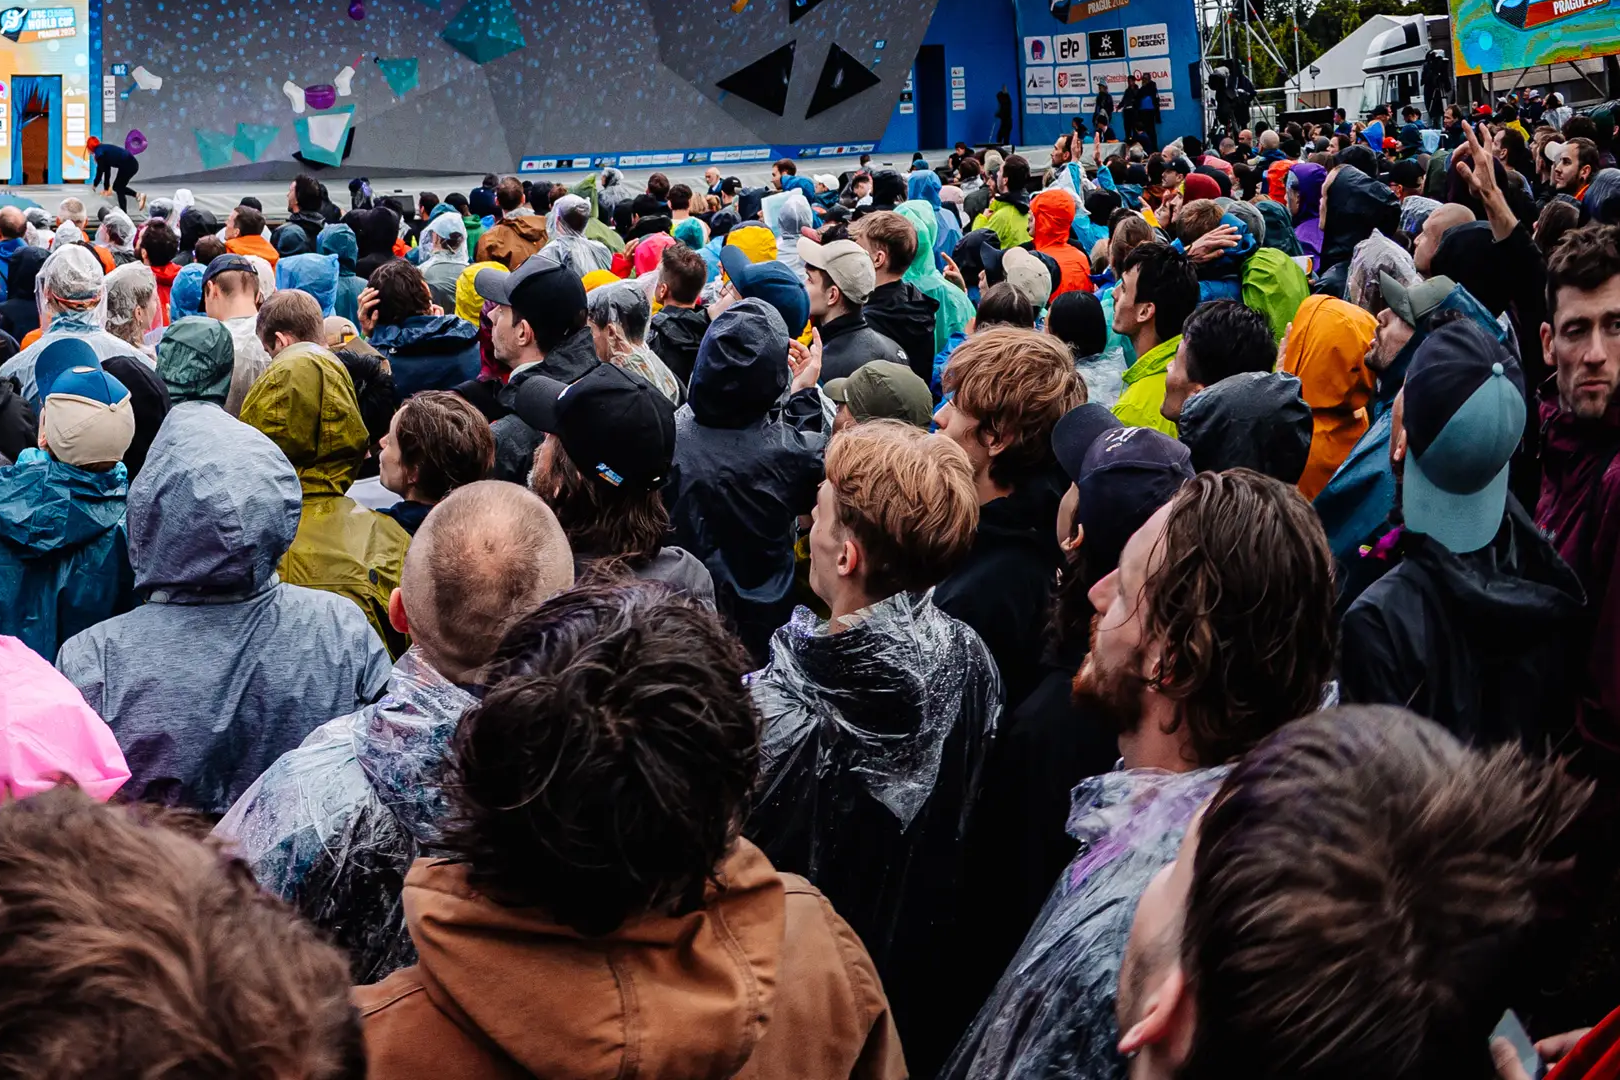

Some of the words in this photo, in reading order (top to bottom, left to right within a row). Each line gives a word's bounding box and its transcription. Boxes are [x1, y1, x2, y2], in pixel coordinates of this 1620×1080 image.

[27, 18, 56, 29] WORLD
[57, 17, 74, 28] CUP
[1137, 33, 1165, 41] PERFECT
[1137, 39, 1166, 48] DESCENT
